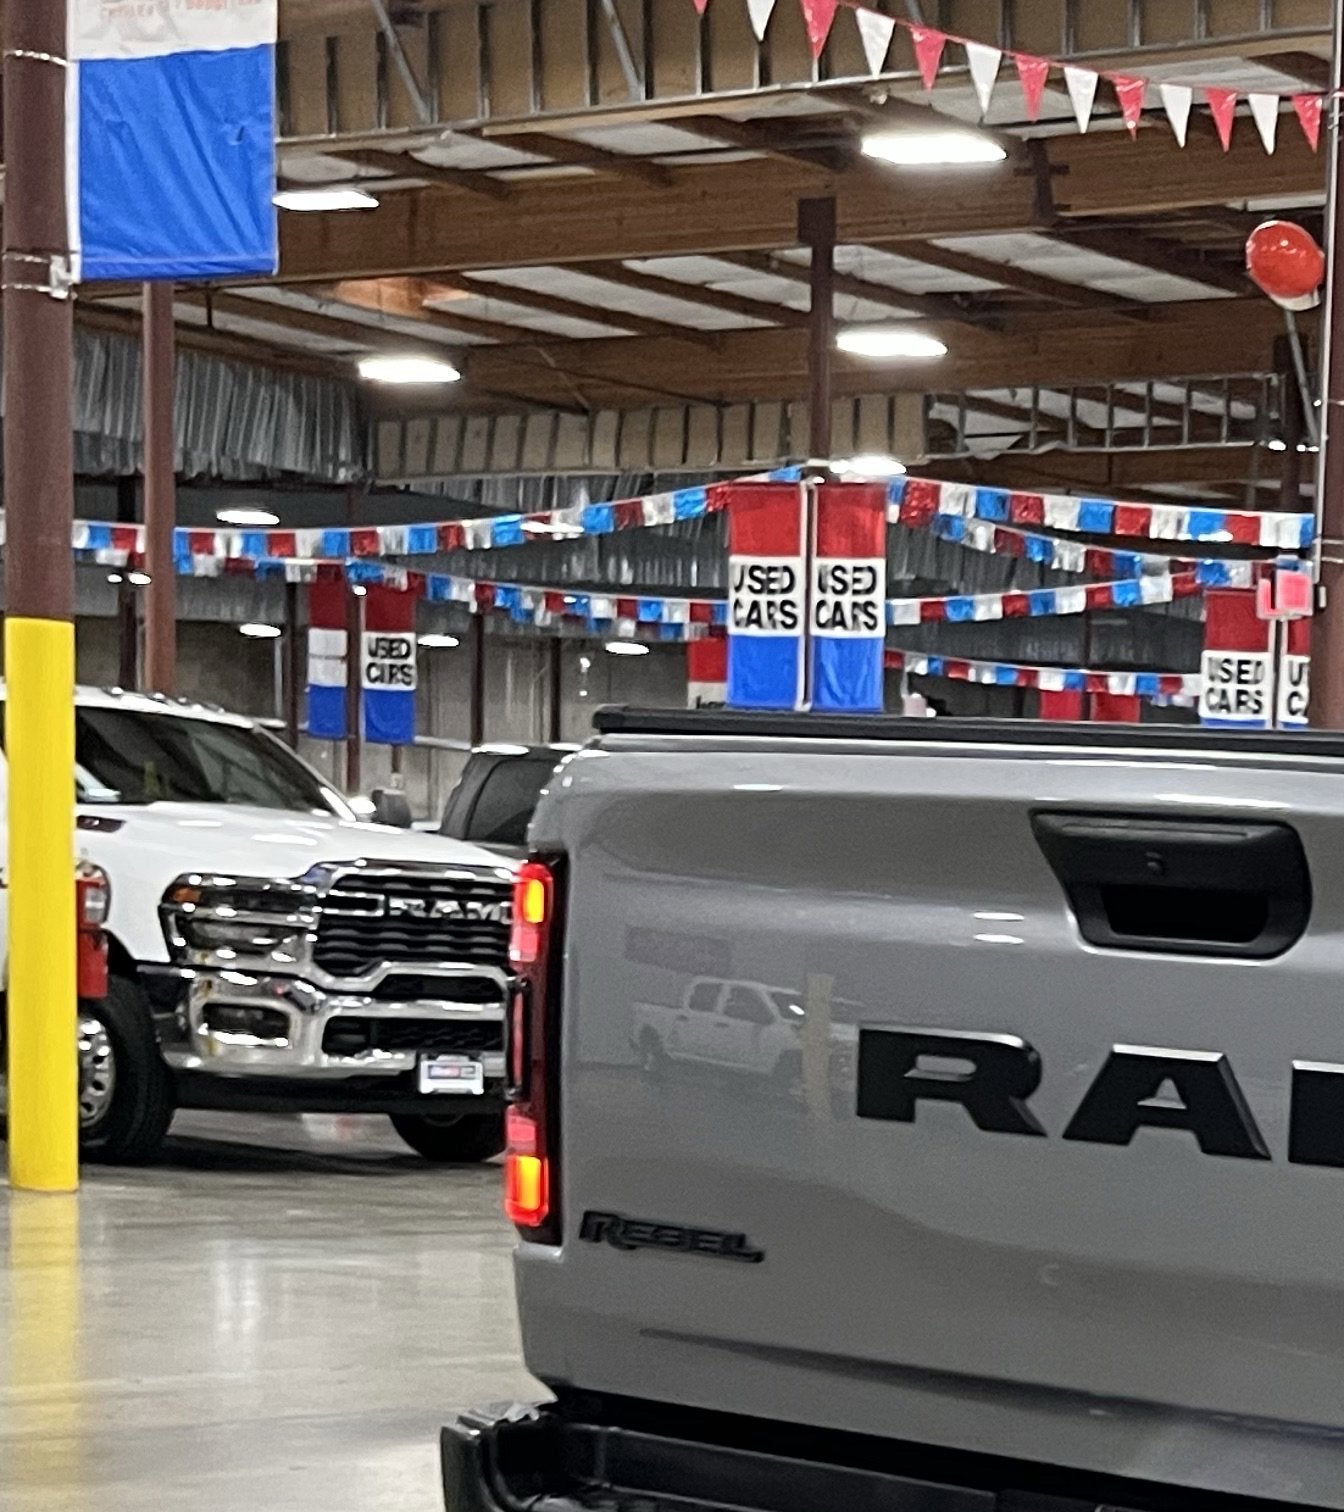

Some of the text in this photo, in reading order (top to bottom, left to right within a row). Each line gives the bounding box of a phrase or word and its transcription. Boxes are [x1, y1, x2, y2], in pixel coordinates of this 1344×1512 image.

[732, 564, 796, 596] USED
[817, 564, 878, 596] USED
[732, 598, 799, 631] CARS
[815, 599, 879, 631] CARS
[367, 637, 412, 660] USED
[1207, 656, 1266, 685] USED
[1206, 687, 1264, 715] CARS
[579, 1210, 766, 1264] REBEL
